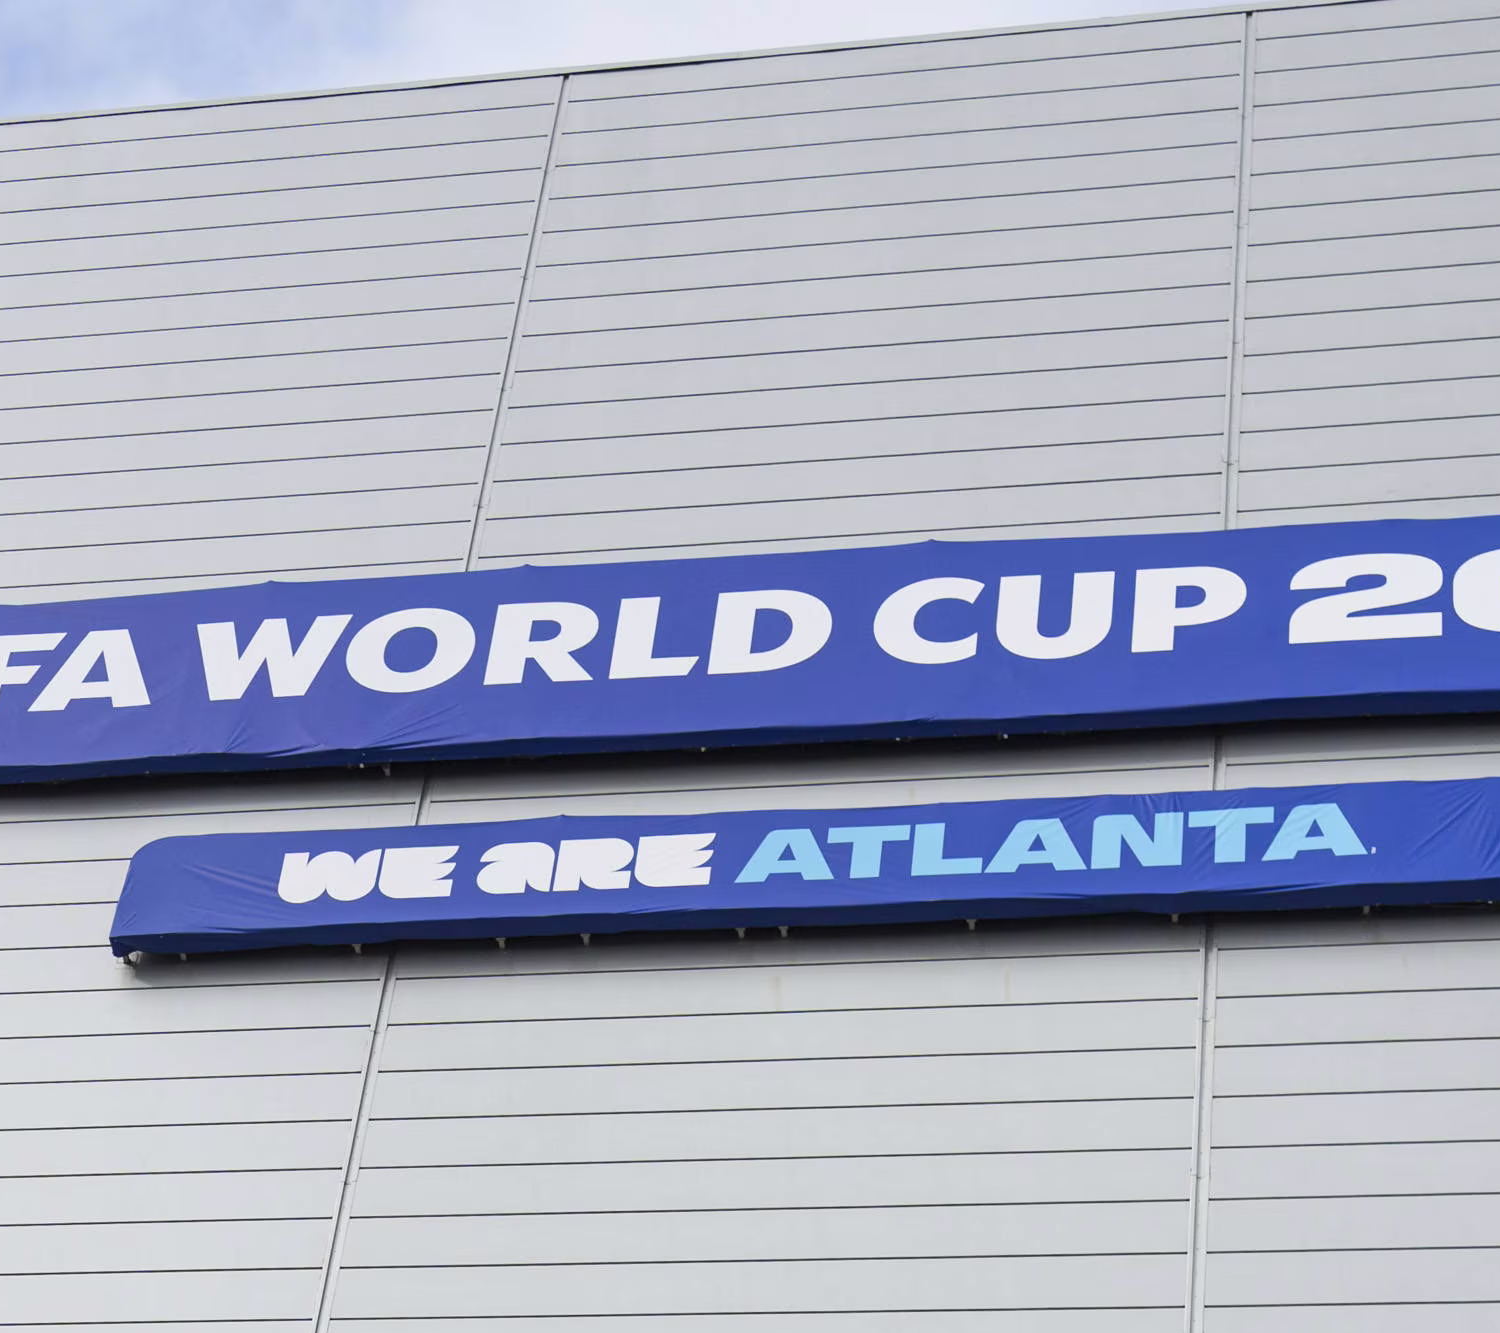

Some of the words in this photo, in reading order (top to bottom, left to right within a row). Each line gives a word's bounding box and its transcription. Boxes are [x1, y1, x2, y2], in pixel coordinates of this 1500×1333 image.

[197, 587, 833, 702] WORLD
[872, 565, 1247, 664] CUP
[277, 845, 460, 904] WE
[734, 802, 1368, 884] ATLANTA
